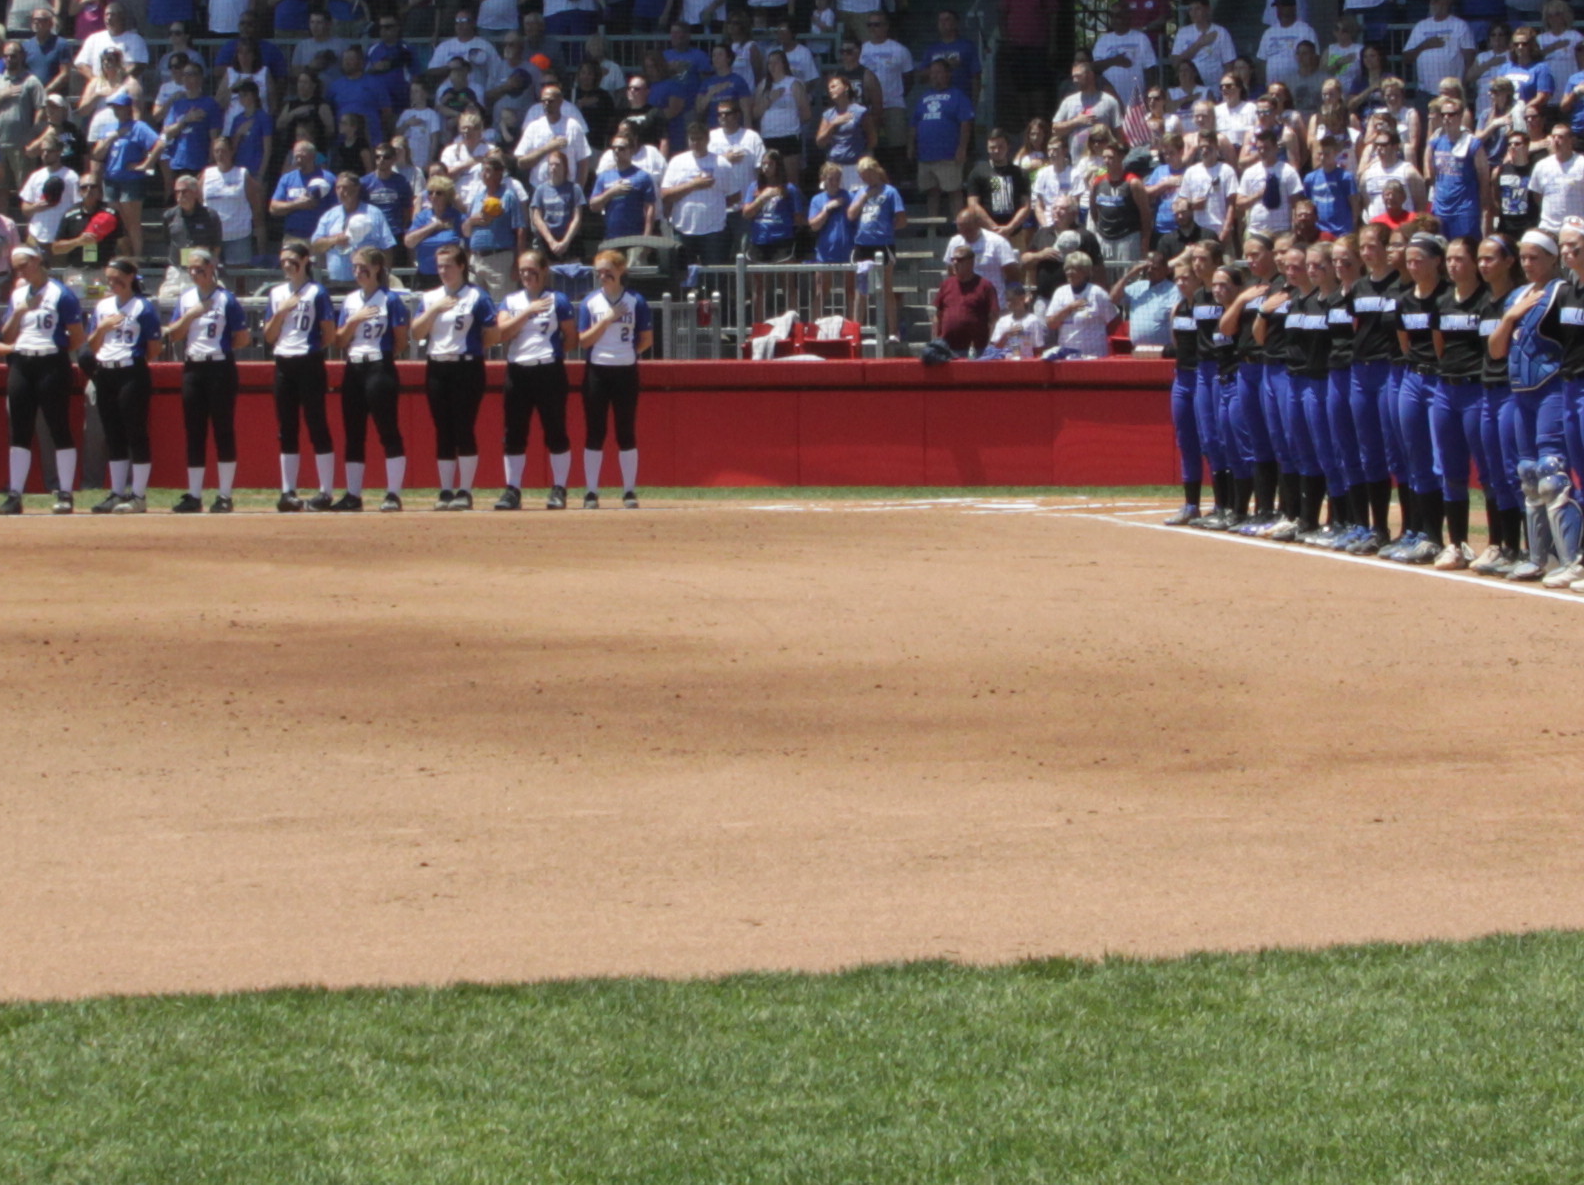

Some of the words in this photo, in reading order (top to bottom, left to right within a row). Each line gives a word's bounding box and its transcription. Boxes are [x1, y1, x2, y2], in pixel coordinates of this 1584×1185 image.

[35, 314, 53, 329] 16
[294, 316, 309, 332] 10
[454, 316, 464, 331] 5
[207, 323, 218, 339] 8
[363, 323, 384, 339] 27
[621, 327, 629, 342] 2
